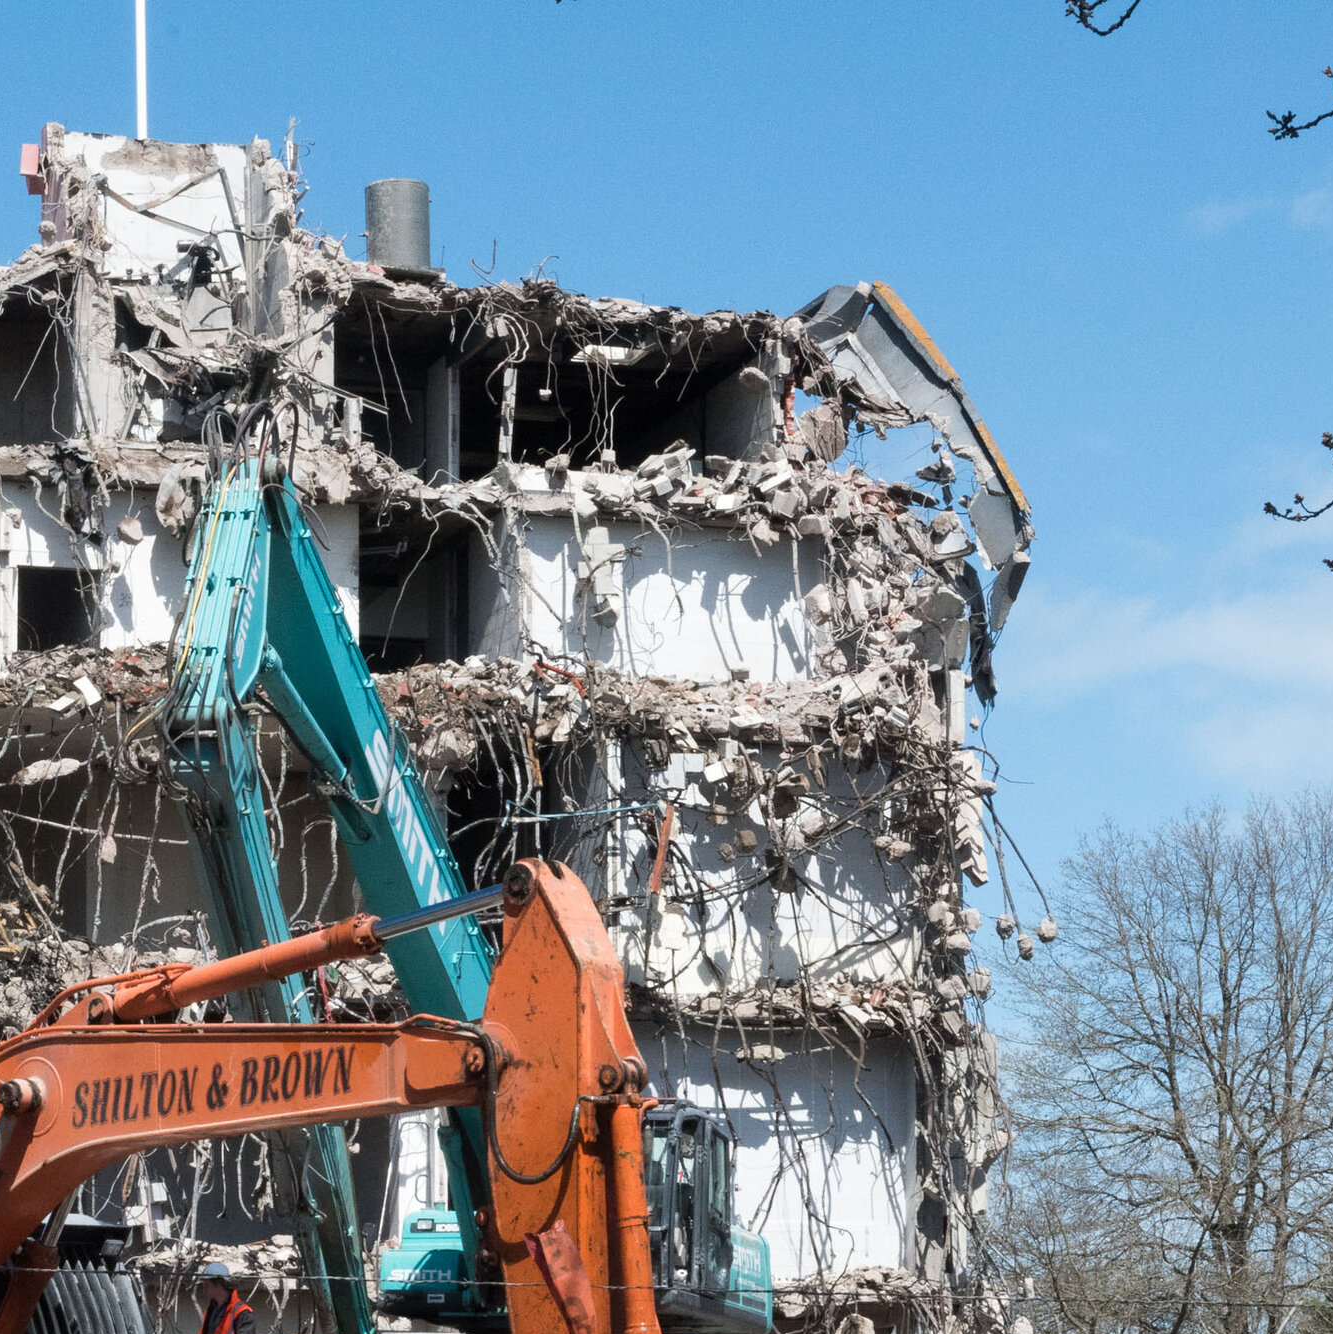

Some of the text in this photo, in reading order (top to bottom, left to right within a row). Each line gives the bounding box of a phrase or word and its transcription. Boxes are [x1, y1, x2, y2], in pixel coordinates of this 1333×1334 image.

[72, 1043, 356, 1129] SHILTON & BROWN
[386, 1269, 452, 1282] SMITH
